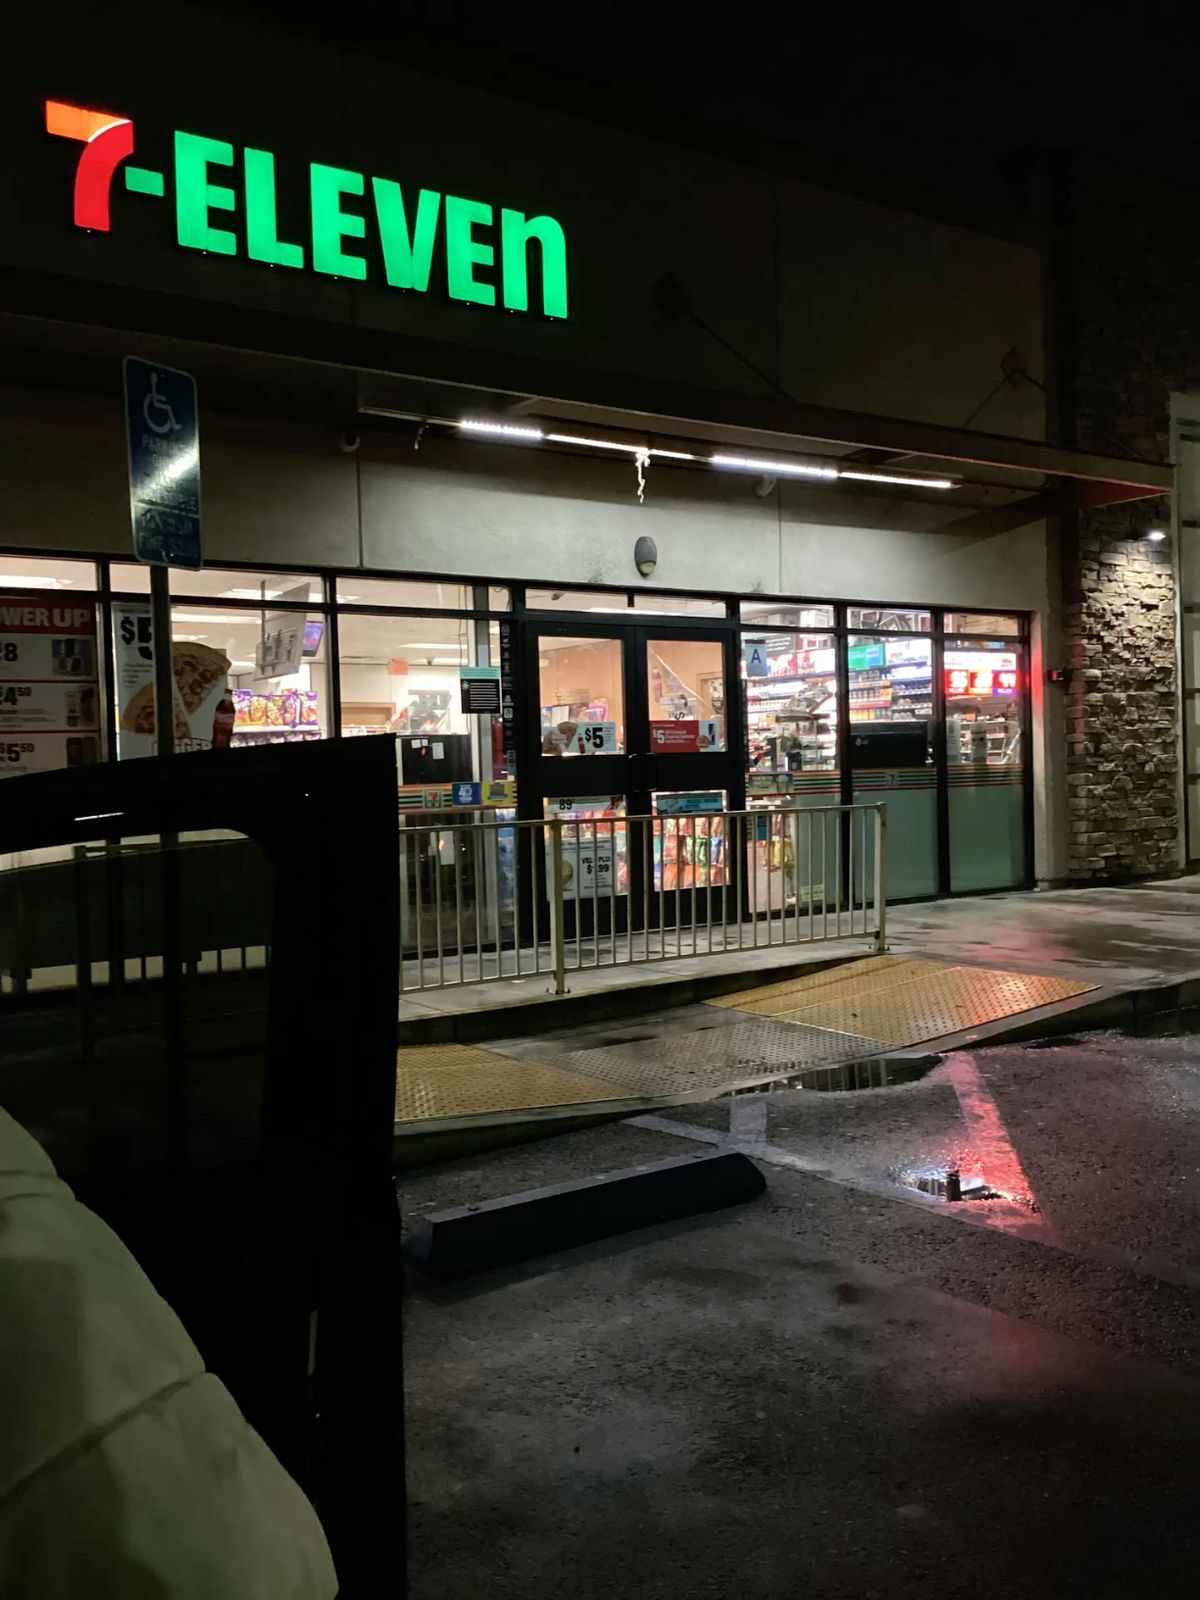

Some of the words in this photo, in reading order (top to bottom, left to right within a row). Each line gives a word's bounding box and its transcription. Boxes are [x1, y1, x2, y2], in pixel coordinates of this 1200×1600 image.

[0, 607, 50, 627] WER
[52, 608, 91, 628] UP
[751, 648, 762, 664] A
[585, 726, 604, 749] $5
